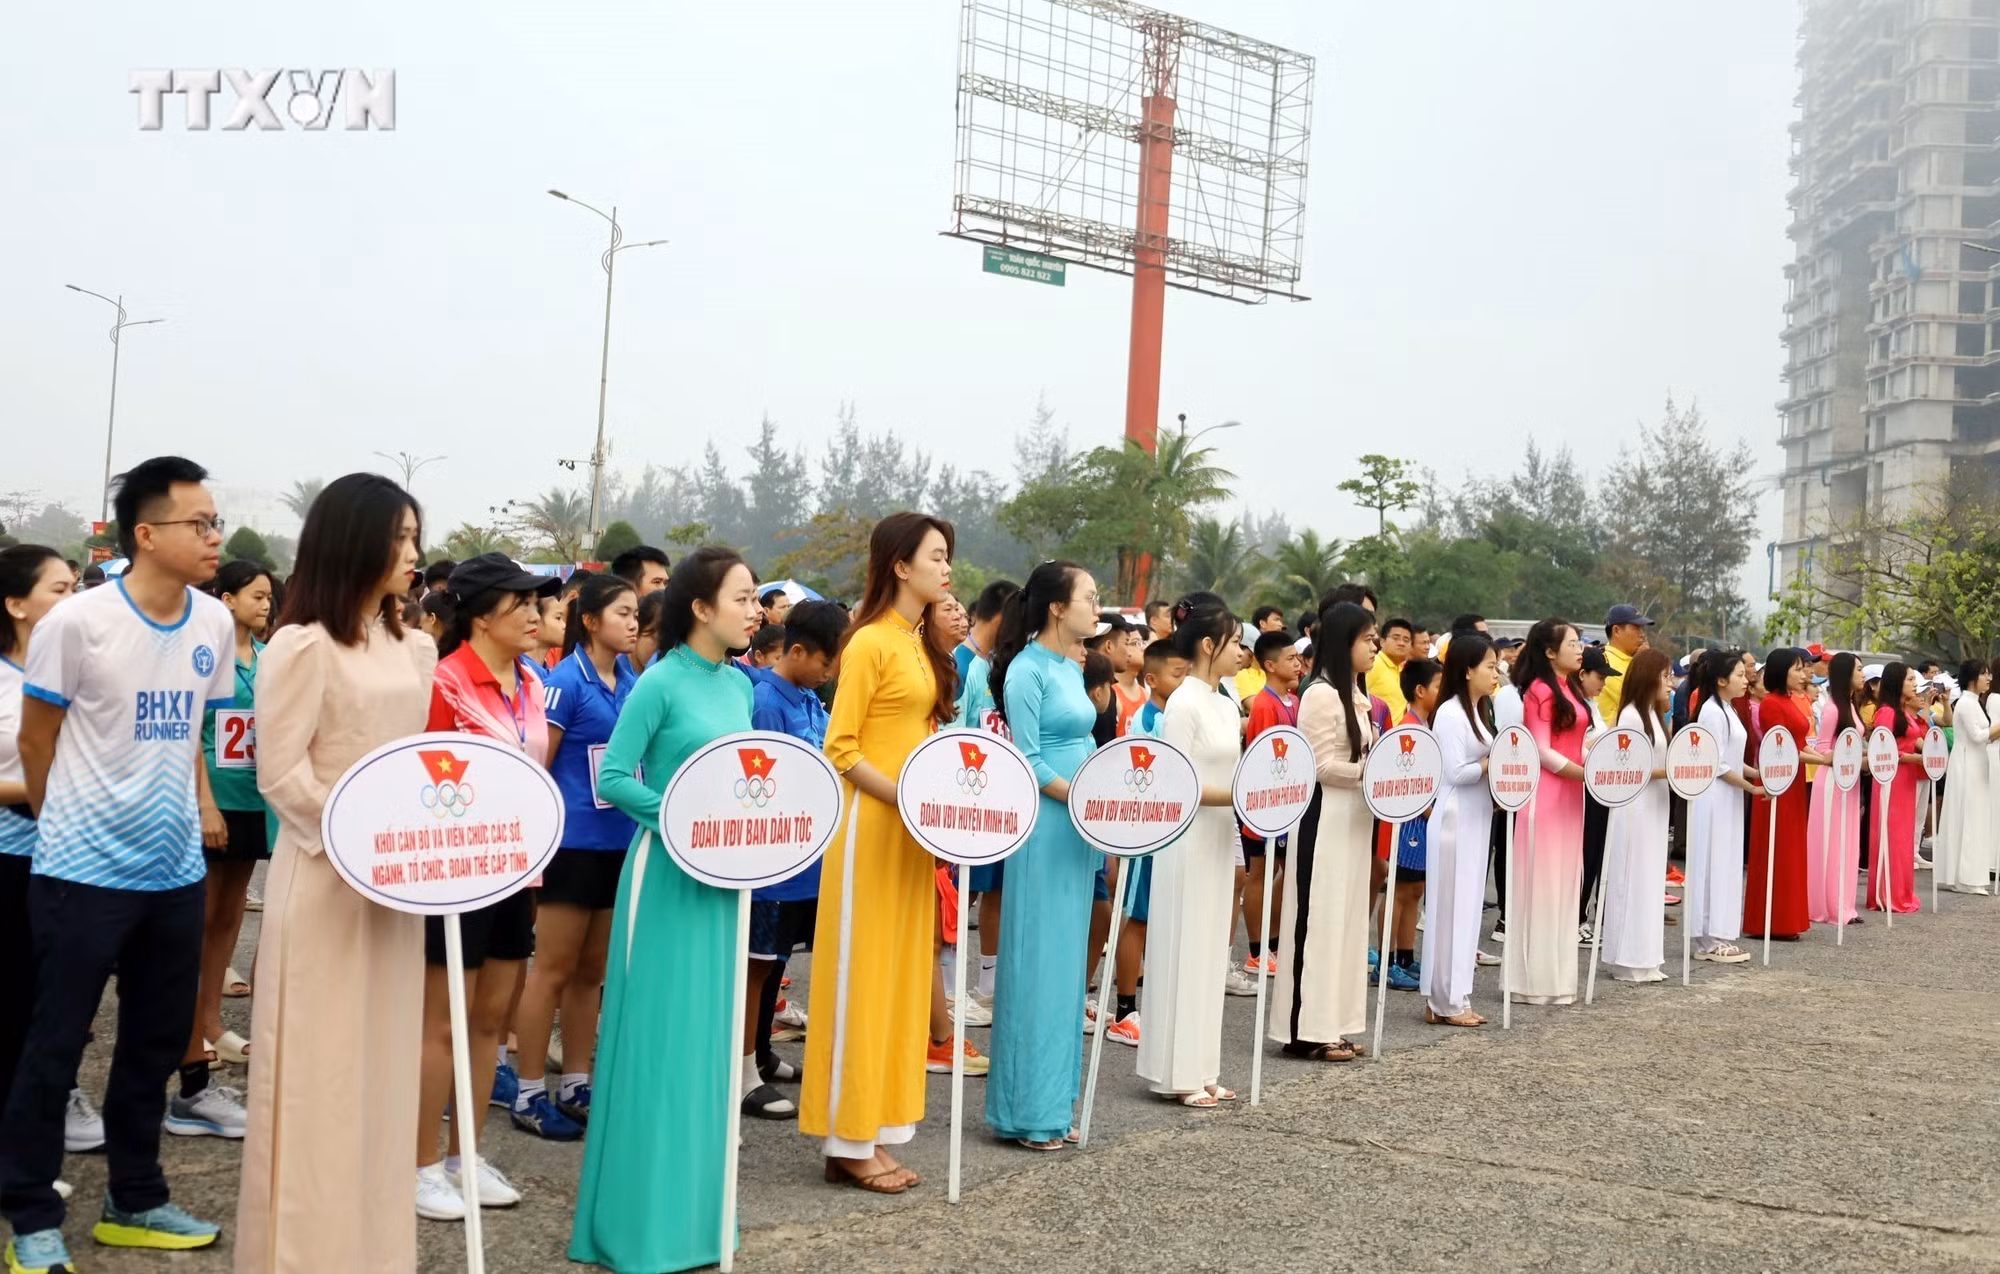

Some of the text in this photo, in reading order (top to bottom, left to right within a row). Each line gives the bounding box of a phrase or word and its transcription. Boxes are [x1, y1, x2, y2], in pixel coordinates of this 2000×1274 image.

[1000, 263, 1019, 275] 0905
[1020, 267, 1035, 278] 822
[134, 721, 190, 741] RUNNER
[920, 798, 1018, 837] ĐOÀN VĐV HUYỆN MINH HÓA
[1084, 794, 1182, 827] ĐOÀN VĐV HUYỆN QUẢNG NINH
[374, 825, 395, 853] KHỐI
[398, 826, 416, 852] CÁN
[418, 825, 430, 854] BỘ
[432, 825, 443, 849] VÀ
[445, 823, 465, 847] VIÊN
[467, 820, 489, 846] CHỨC
[491, 820, 507, 844] CÁC
[691, 811, 812, 849] ĐOÀN VĐV BAN DÂN TỘC
[372, 860, 406, 887] NGÀNH,
[408, 855, 419, 882] TỔ
[450, 854, 471, 878] ĐOÀN
[474, 848, 489, 875] THỂ
[491, 847, 507, 874] CẤP
[509, 846, 528, 872] TỈNH
